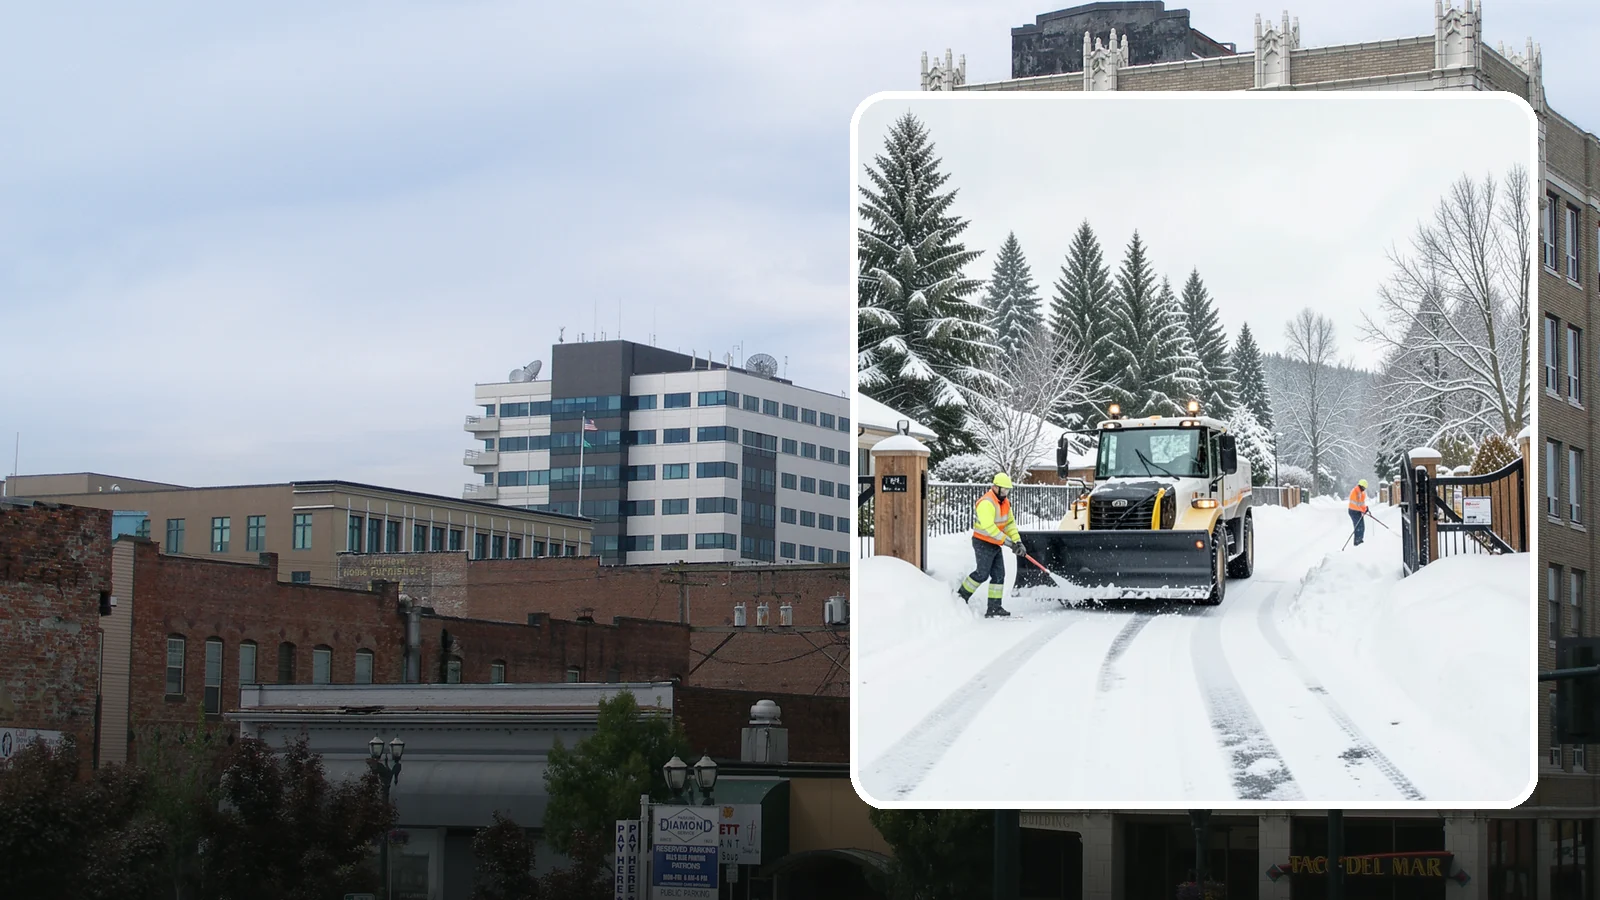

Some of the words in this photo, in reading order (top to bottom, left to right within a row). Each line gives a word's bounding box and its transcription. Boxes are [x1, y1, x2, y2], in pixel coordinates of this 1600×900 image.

[370, 566, 427, 577] Furnishers
[660, 818, 713, 833] DIAMOND
[1022, 815, 1070, 828] BUILDING
[617, 824, 625, 852] PAY
[628, 824, 637, 852] PAY
[655, 845, 688, 853] RESERVED
[689, 846, 716, 854] PARKING
[721, 851, 739, 862] Soup
[671, 862, 701, 870] PATRONS
[1346, 856, 1385, 875] DEL
[1392, 857, 1443, 877] MAR
[616, 856, 625, 893] HERE
[627, 856, 636, 893] HERE
[660, 888, 682, 897] PUBLIC
[683, 889, 710, 898] PARKING
